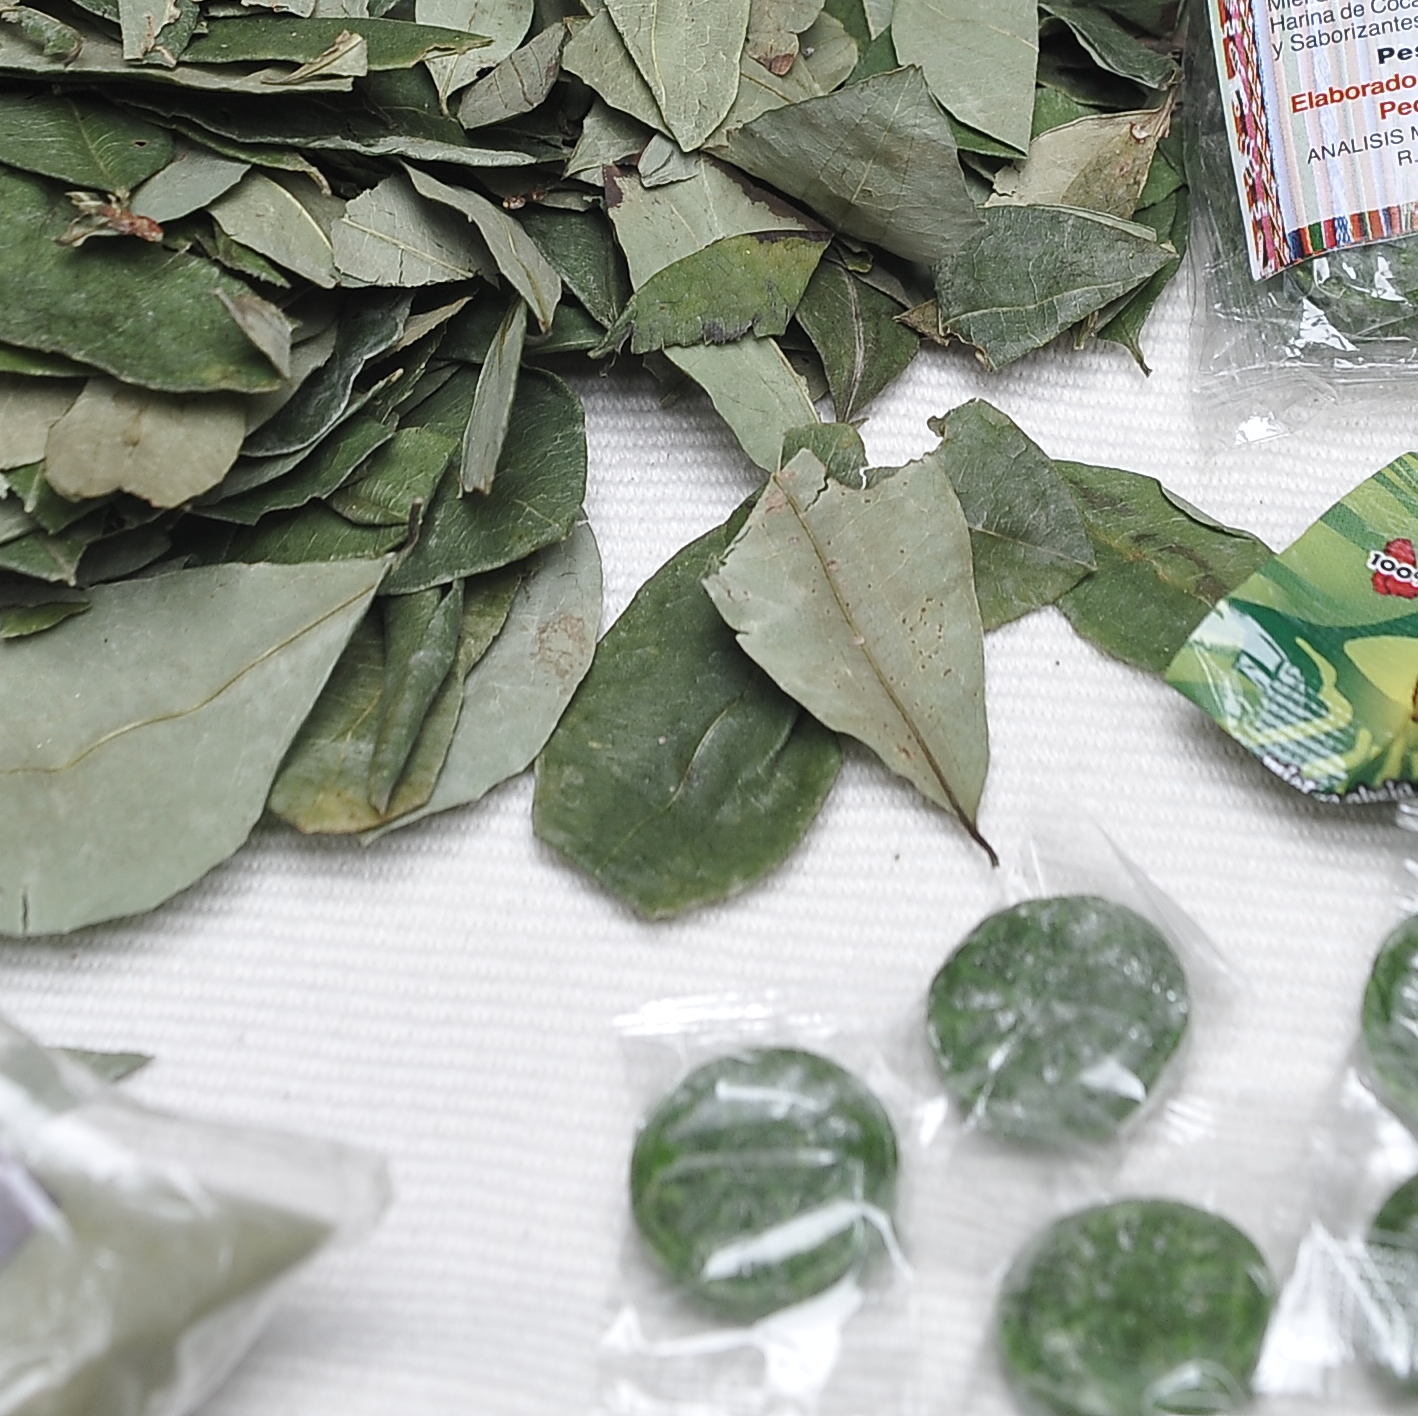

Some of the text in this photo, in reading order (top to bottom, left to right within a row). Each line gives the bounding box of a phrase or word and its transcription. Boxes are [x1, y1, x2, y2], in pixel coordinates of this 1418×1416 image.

[1269, 6, 1336, 34] Harina
[1340, 0, 1366, 19] de
[1271, 40, 1285, 61] y
[1291, 73, 1417, 114] Elaborado
[1307, 129, 1404, 165] ANALISIS
